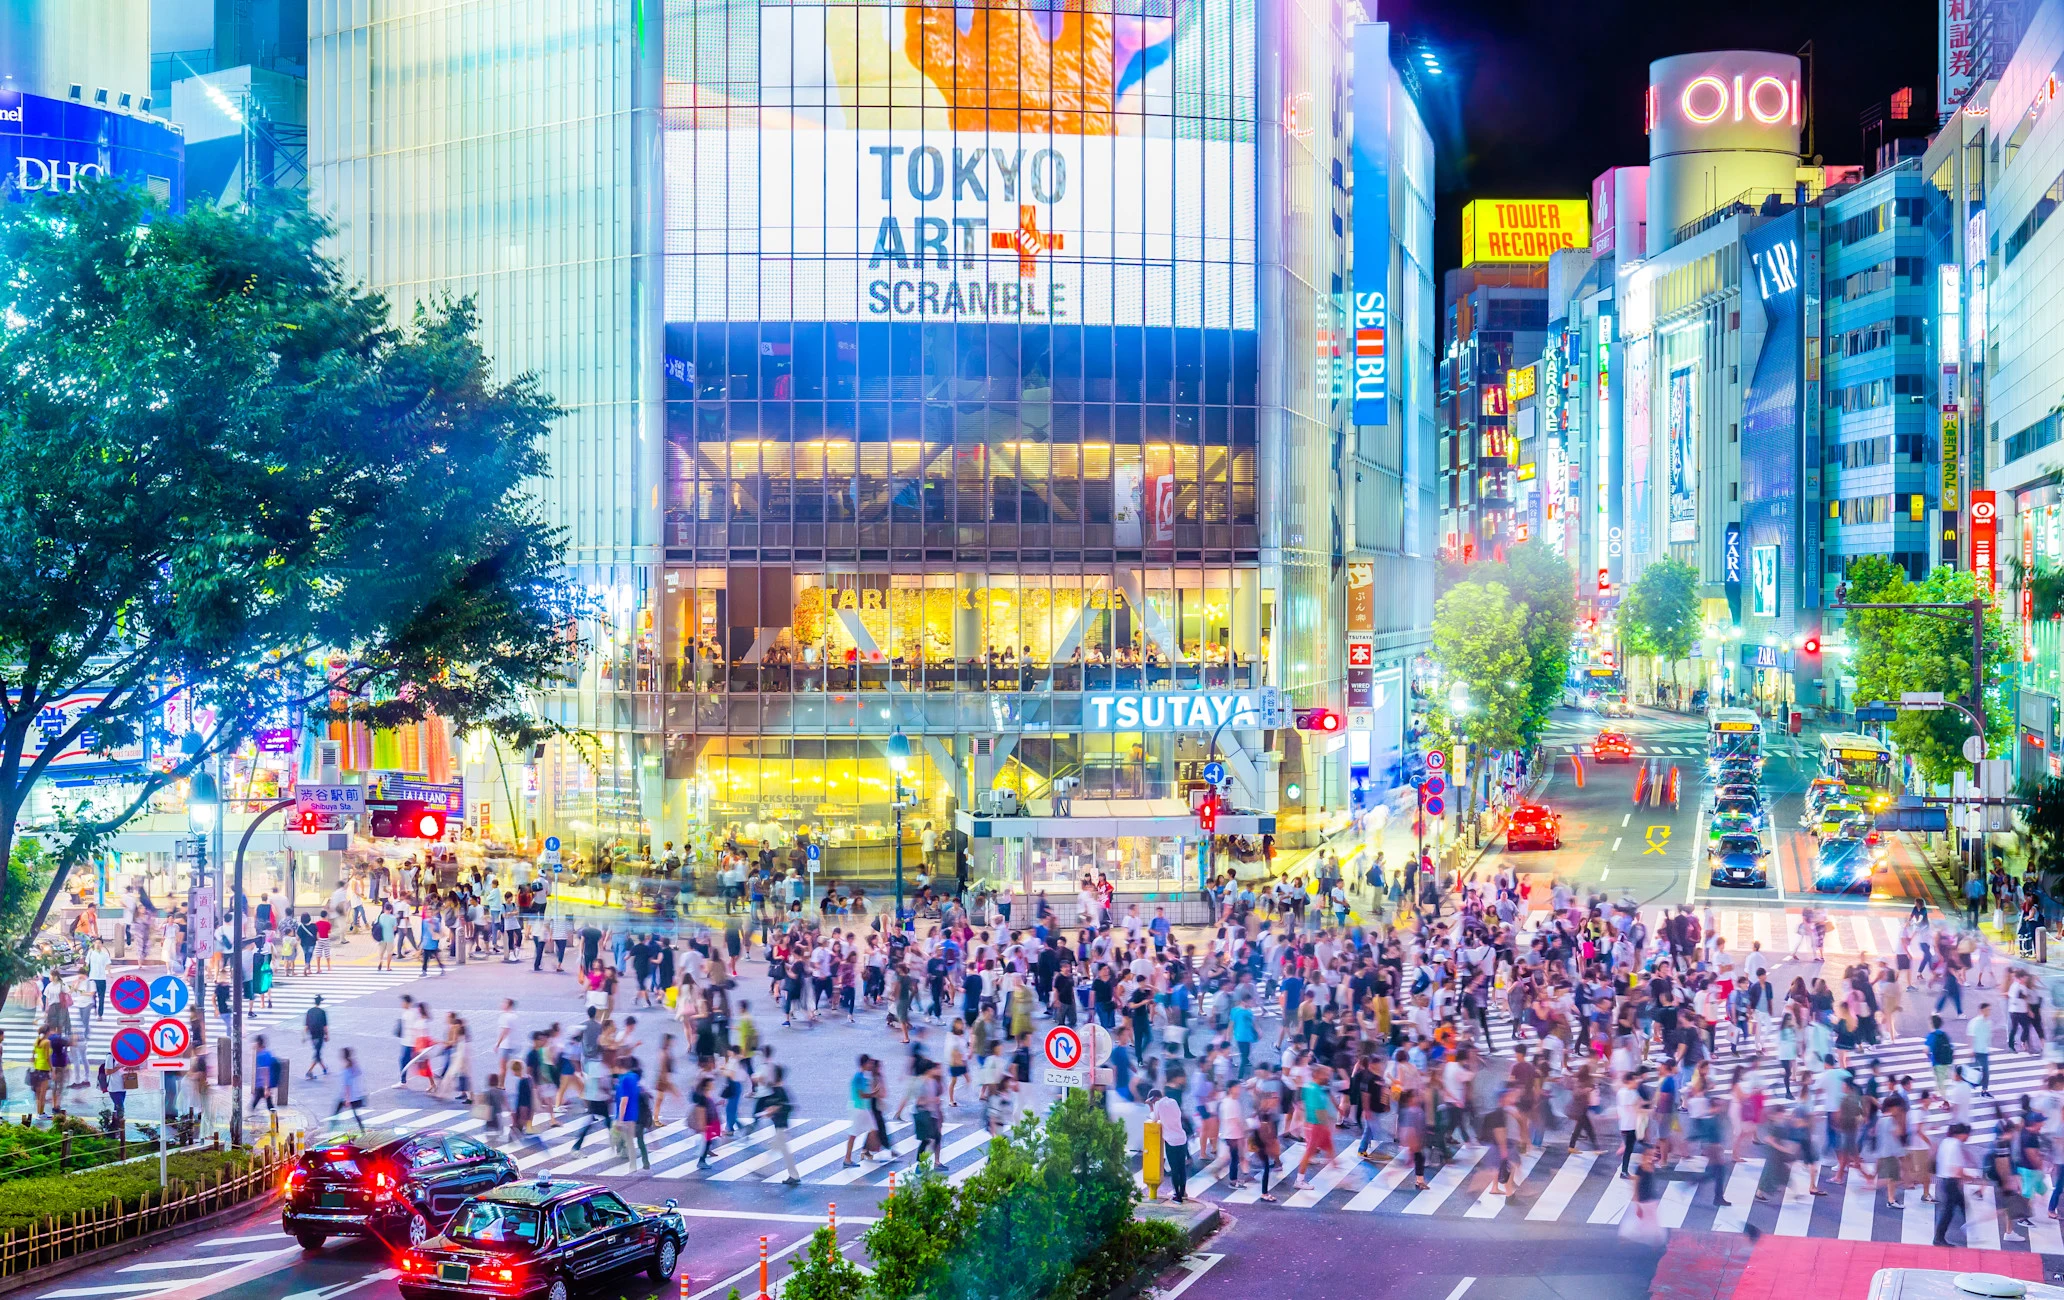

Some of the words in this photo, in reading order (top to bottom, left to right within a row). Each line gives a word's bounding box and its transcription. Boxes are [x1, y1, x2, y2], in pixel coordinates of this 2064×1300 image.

[868, 145, 1067, 205] TOKYO
[1495, 203, 1561, 229] TOWER
[1488, 231, 1575, 257] RECORDS
[868, 279, 1068, 317] SCRAMBLE
[1355, 291, 1385, 402] SEIBU
[1545, 348, 1558, 432] KARAOKE
[1726, 532, 1740, 582] ZARA
[1352, 645, 1370, 664] 本
[1757, 646, 1777, 666] ZARA
[1090, 695, 1256, 728] TSUTAYA
[1267, 689, 1276, 726] 渋谷駅前
[300, 788, 359, 802] 渋谷駅前
[310, 802, 338, 811] Shibuya
[339, 802, 354, 810] Sta.
[425, 792, 447, 804] LAND
[1046, 1073, 1080, 1085] ここから
